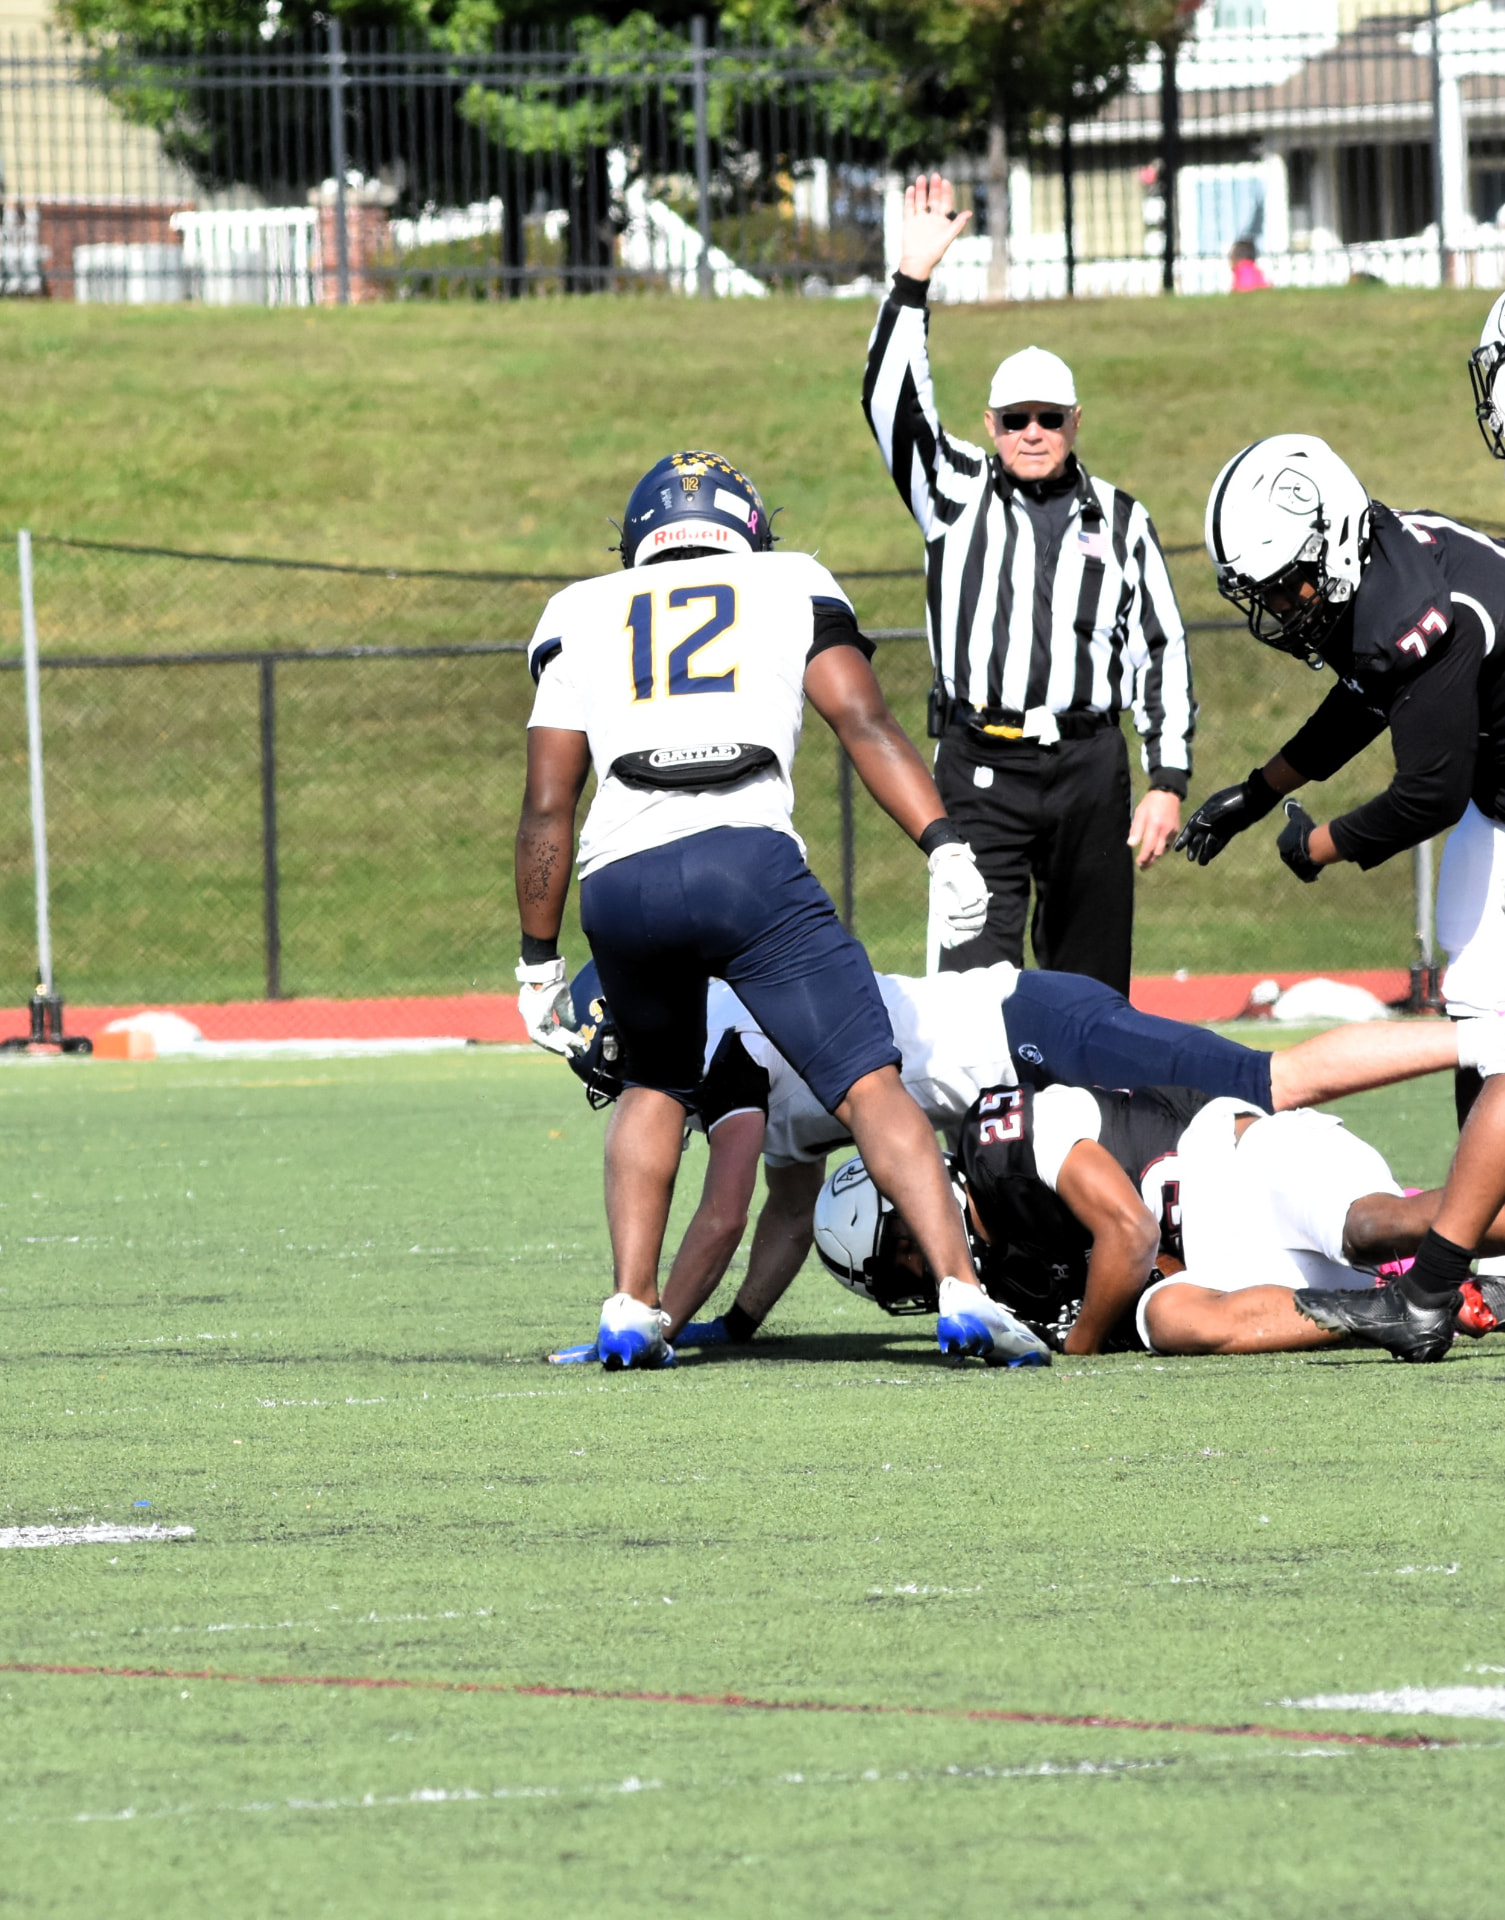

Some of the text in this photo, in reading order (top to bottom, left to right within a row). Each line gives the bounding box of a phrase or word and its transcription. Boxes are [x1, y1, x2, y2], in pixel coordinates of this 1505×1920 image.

[682, 477, 699, 491] 12
[623, 583, 740, 704] 12
[1396, 606, 1448, 659] 77
[657, 746, 732, 764] BATTLE
[979, 1089, 1024, 1146] 52
